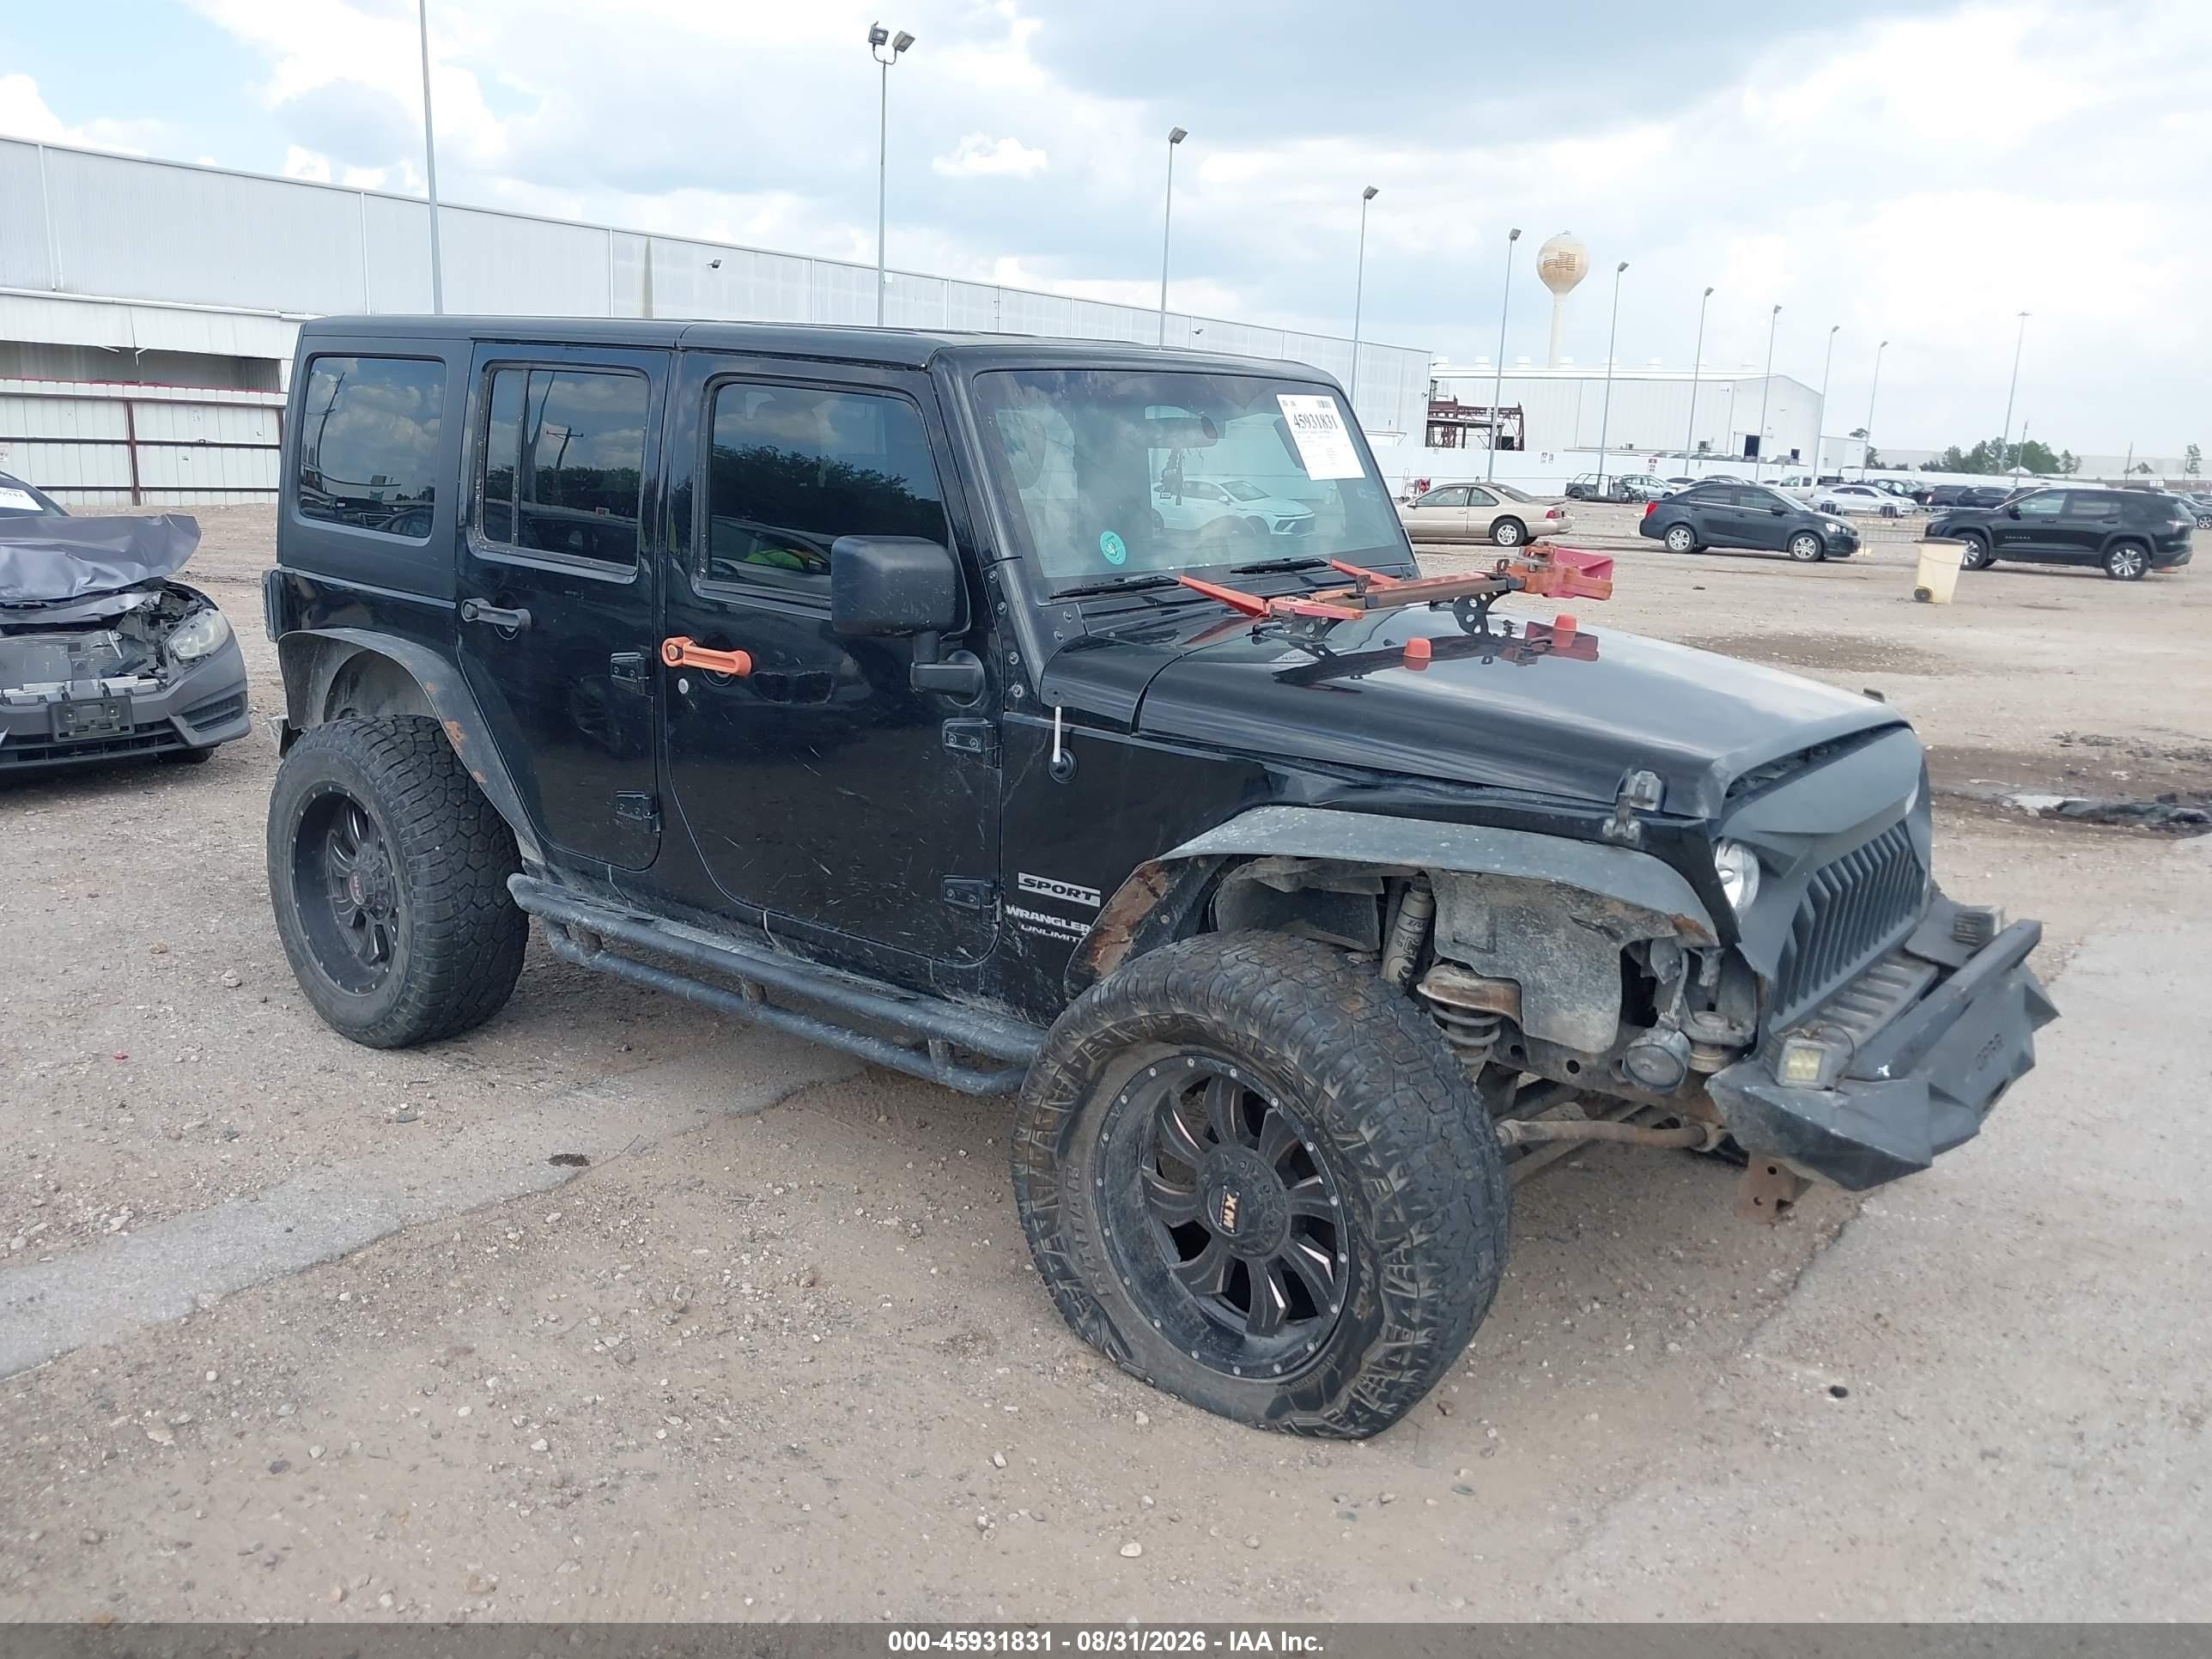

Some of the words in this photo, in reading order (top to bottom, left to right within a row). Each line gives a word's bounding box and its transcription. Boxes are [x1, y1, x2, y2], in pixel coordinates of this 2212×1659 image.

[1293, 414, 1338, 429] 45931831
[1020, 878, 1099, 901] SPORT
[1006, 904, 1091, 936] WRANGLER
[1019, 924, 1082, 943] UNLIMIT
